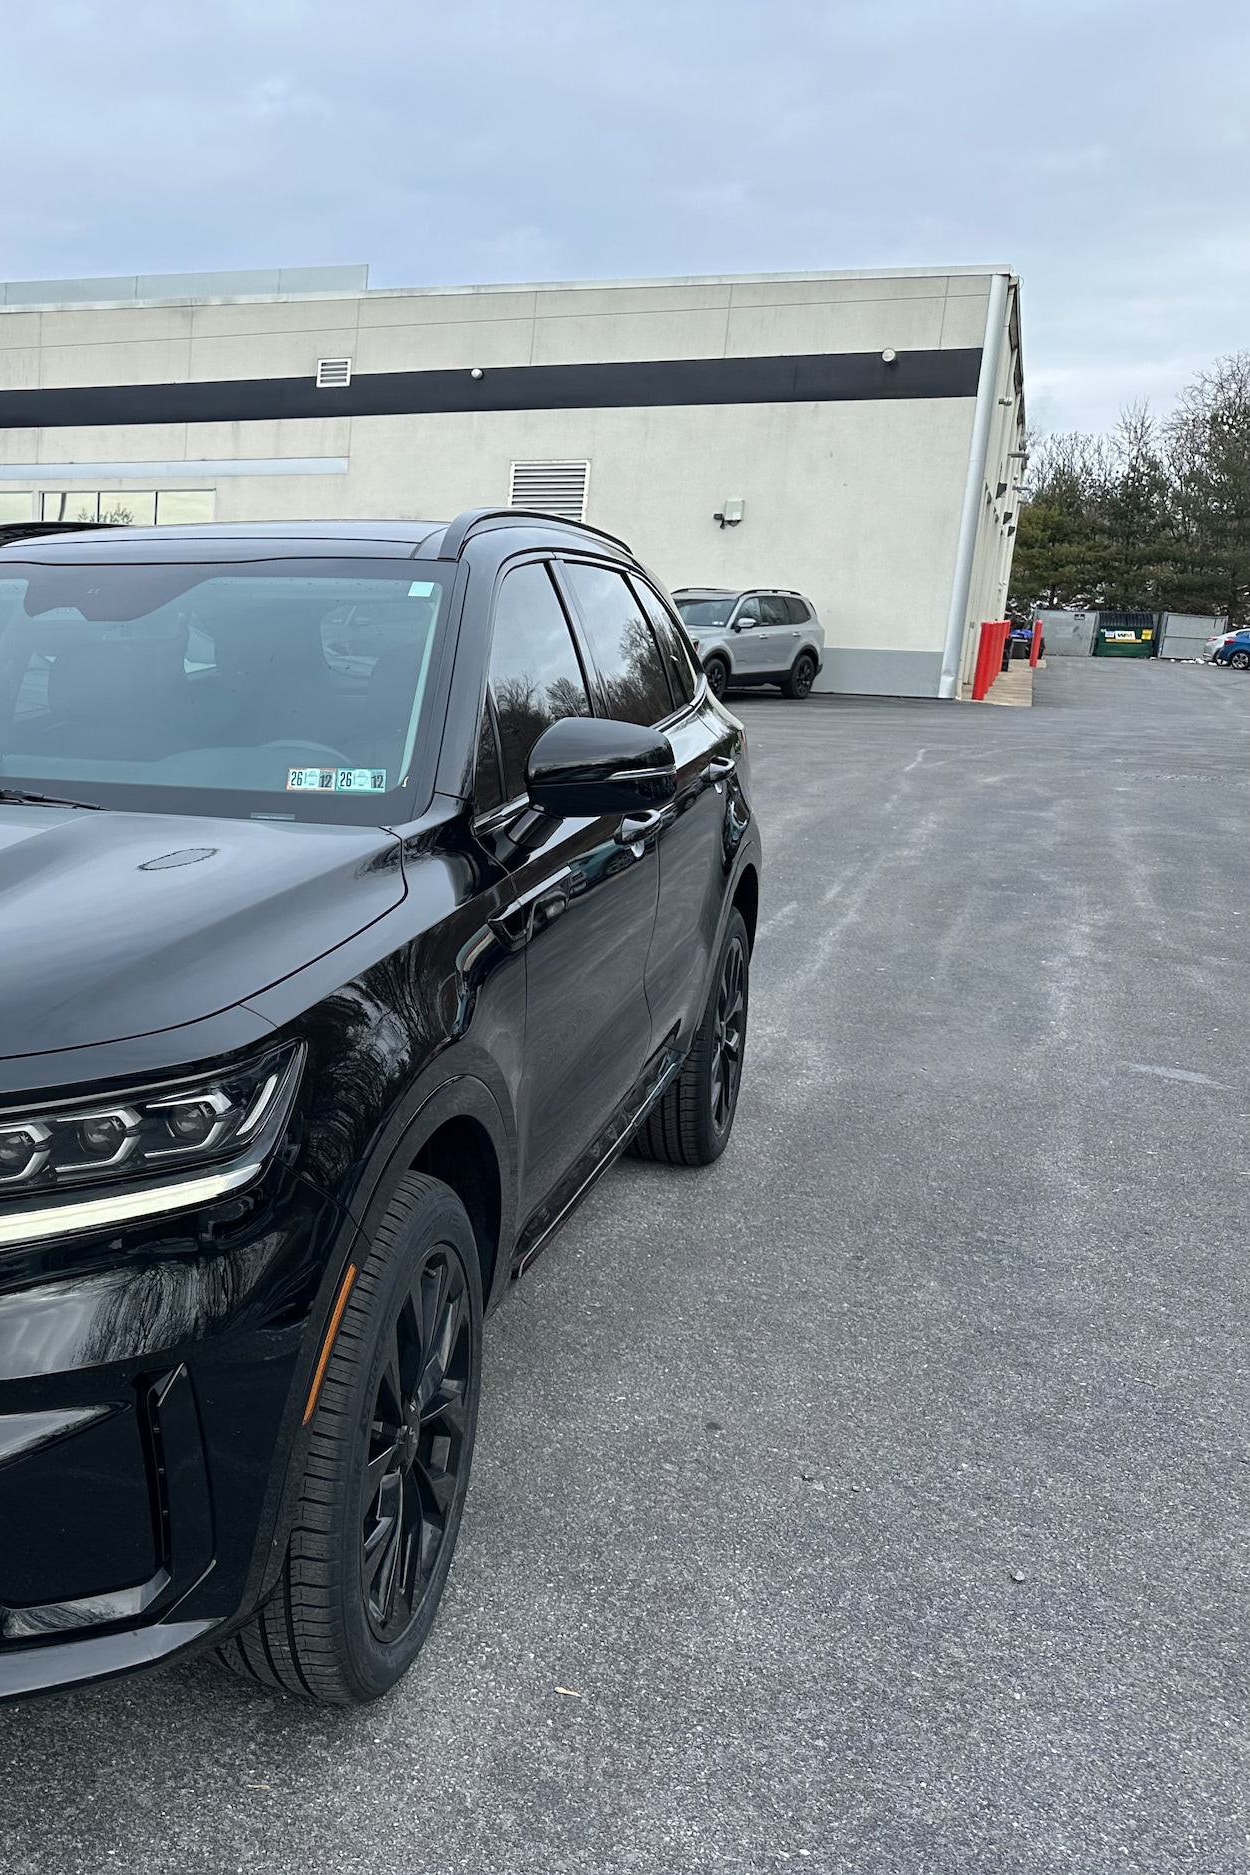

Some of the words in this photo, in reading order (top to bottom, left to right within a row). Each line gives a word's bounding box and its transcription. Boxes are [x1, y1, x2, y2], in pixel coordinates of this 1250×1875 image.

[290, 771, 303, 786] 26
[319, 774, 332, 788] 12
[339, 771, 352, 787] 26
[371, 774, 384, 789] 12
